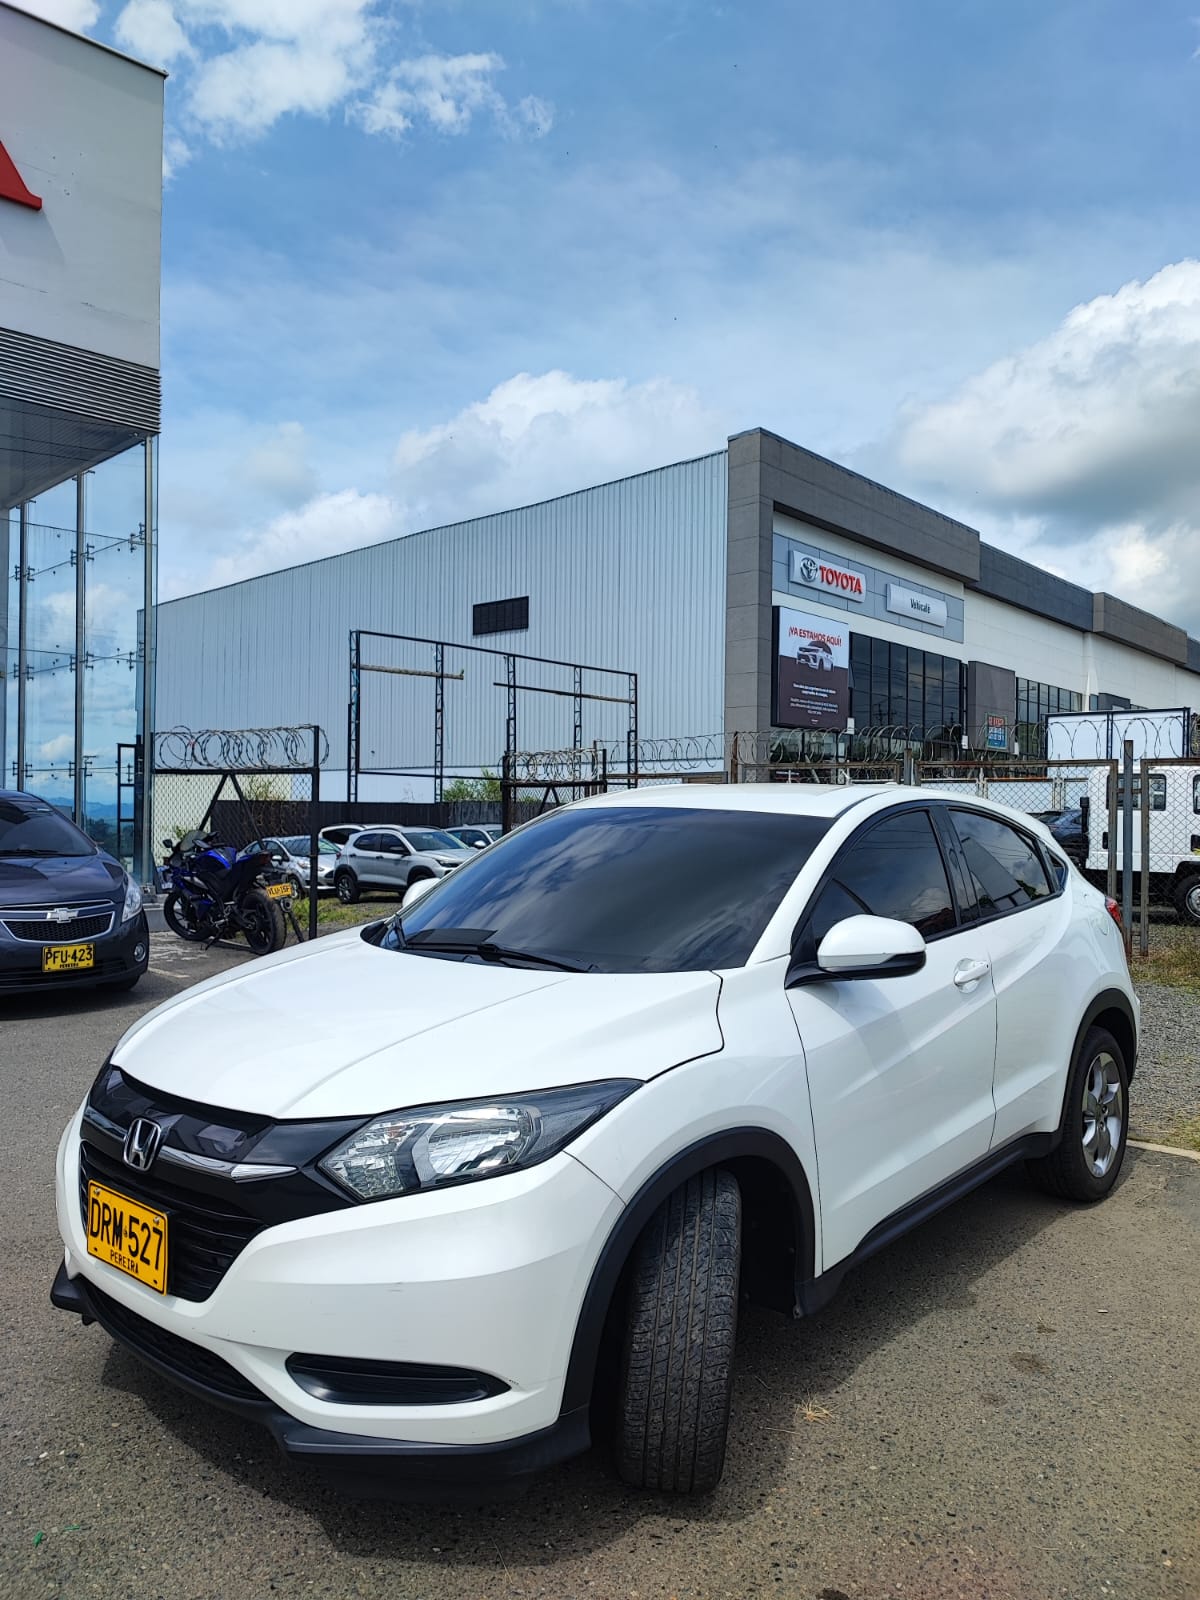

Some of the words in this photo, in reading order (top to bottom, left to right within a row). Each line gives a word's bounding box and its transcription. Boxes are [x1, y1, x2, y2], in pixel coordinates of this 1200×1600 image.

[819, 565, 862, 594] TOYOTA
[799, 628, 826, 642] ESTAMOS
[110, 1249, 139, 1273] PEREIRA
